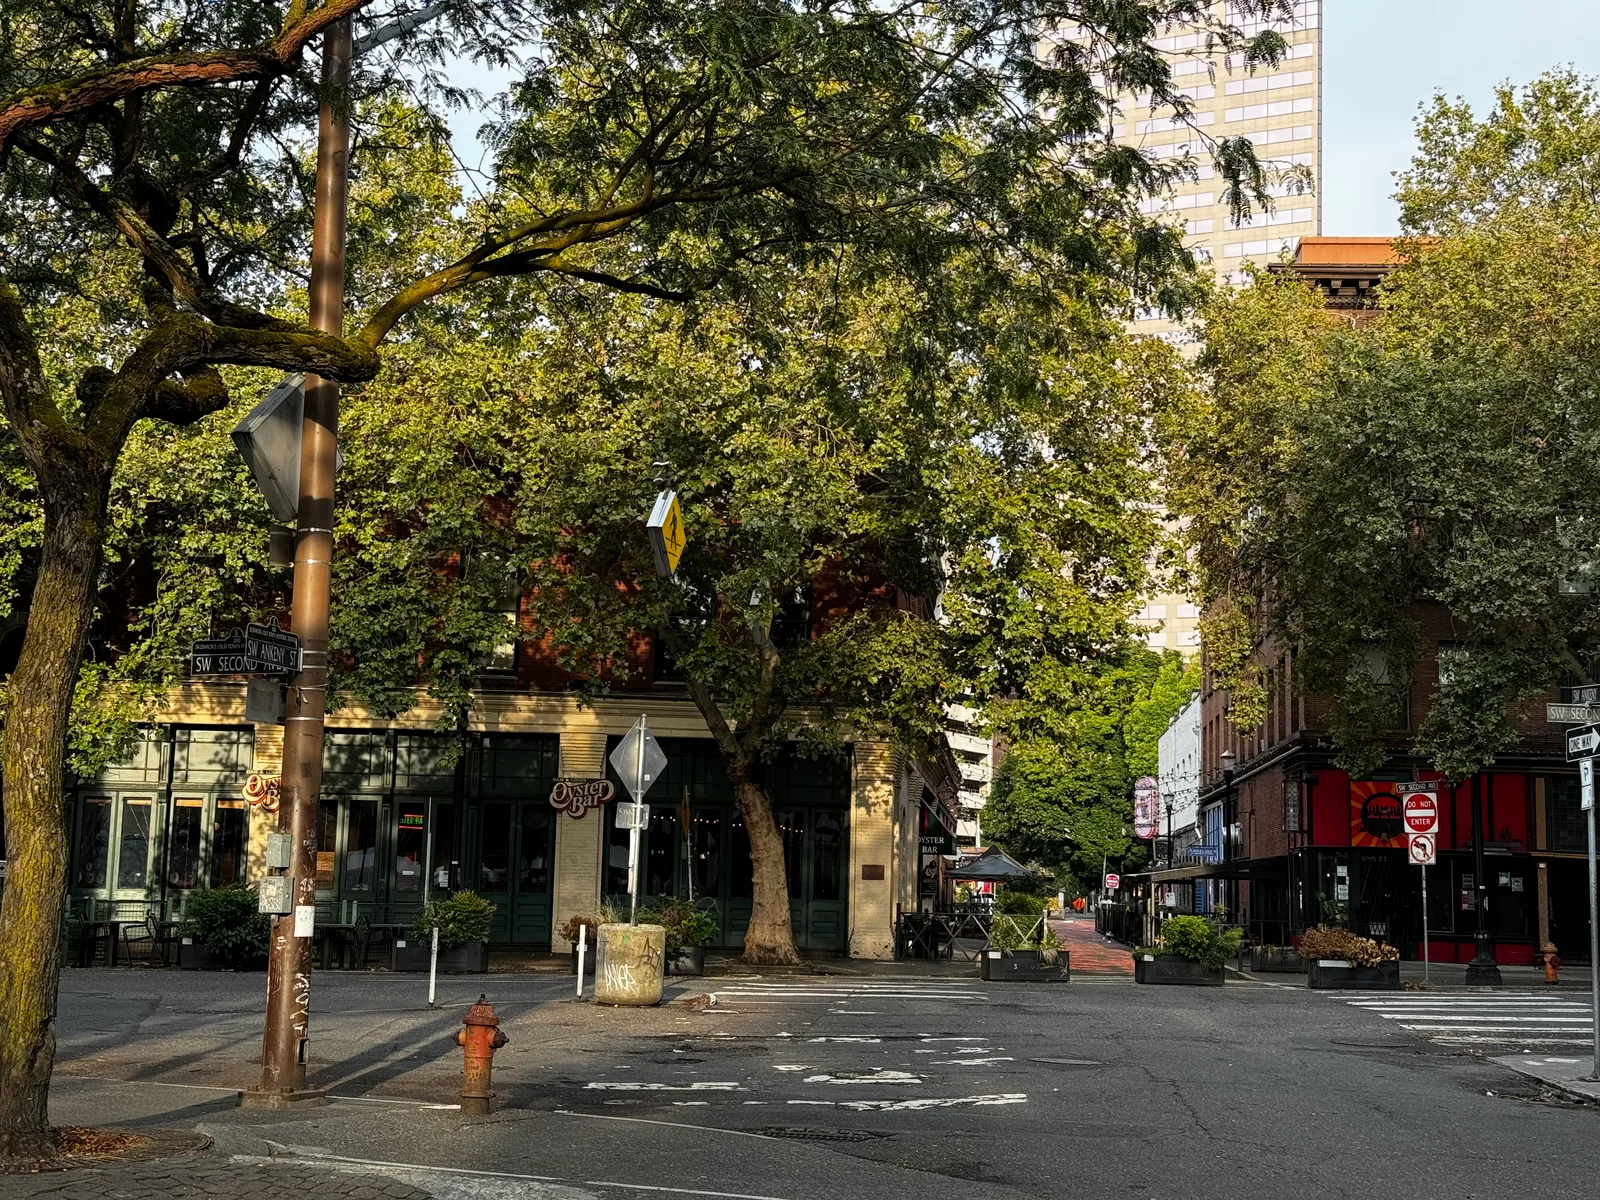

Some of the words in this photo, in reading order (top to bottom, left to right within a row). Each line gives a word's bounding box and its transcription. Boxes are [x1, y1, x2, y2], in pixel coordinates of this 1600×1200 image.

[247, 640, 259, 657] SW
[260, 644, 286, 664] ANKENY
[289, 650, 297, 666] ST
[195, 656, 212, 672] SW
[218, 656, 257, 672] SECOND
[1550, 707, 1564, 720] SW
[1570, 737, 1580, 751] ONE
[1582, 735, 1592, 749] WAY
[549, 780, 615, 809] Oyster
[567, 793, 604, 818] Bar
